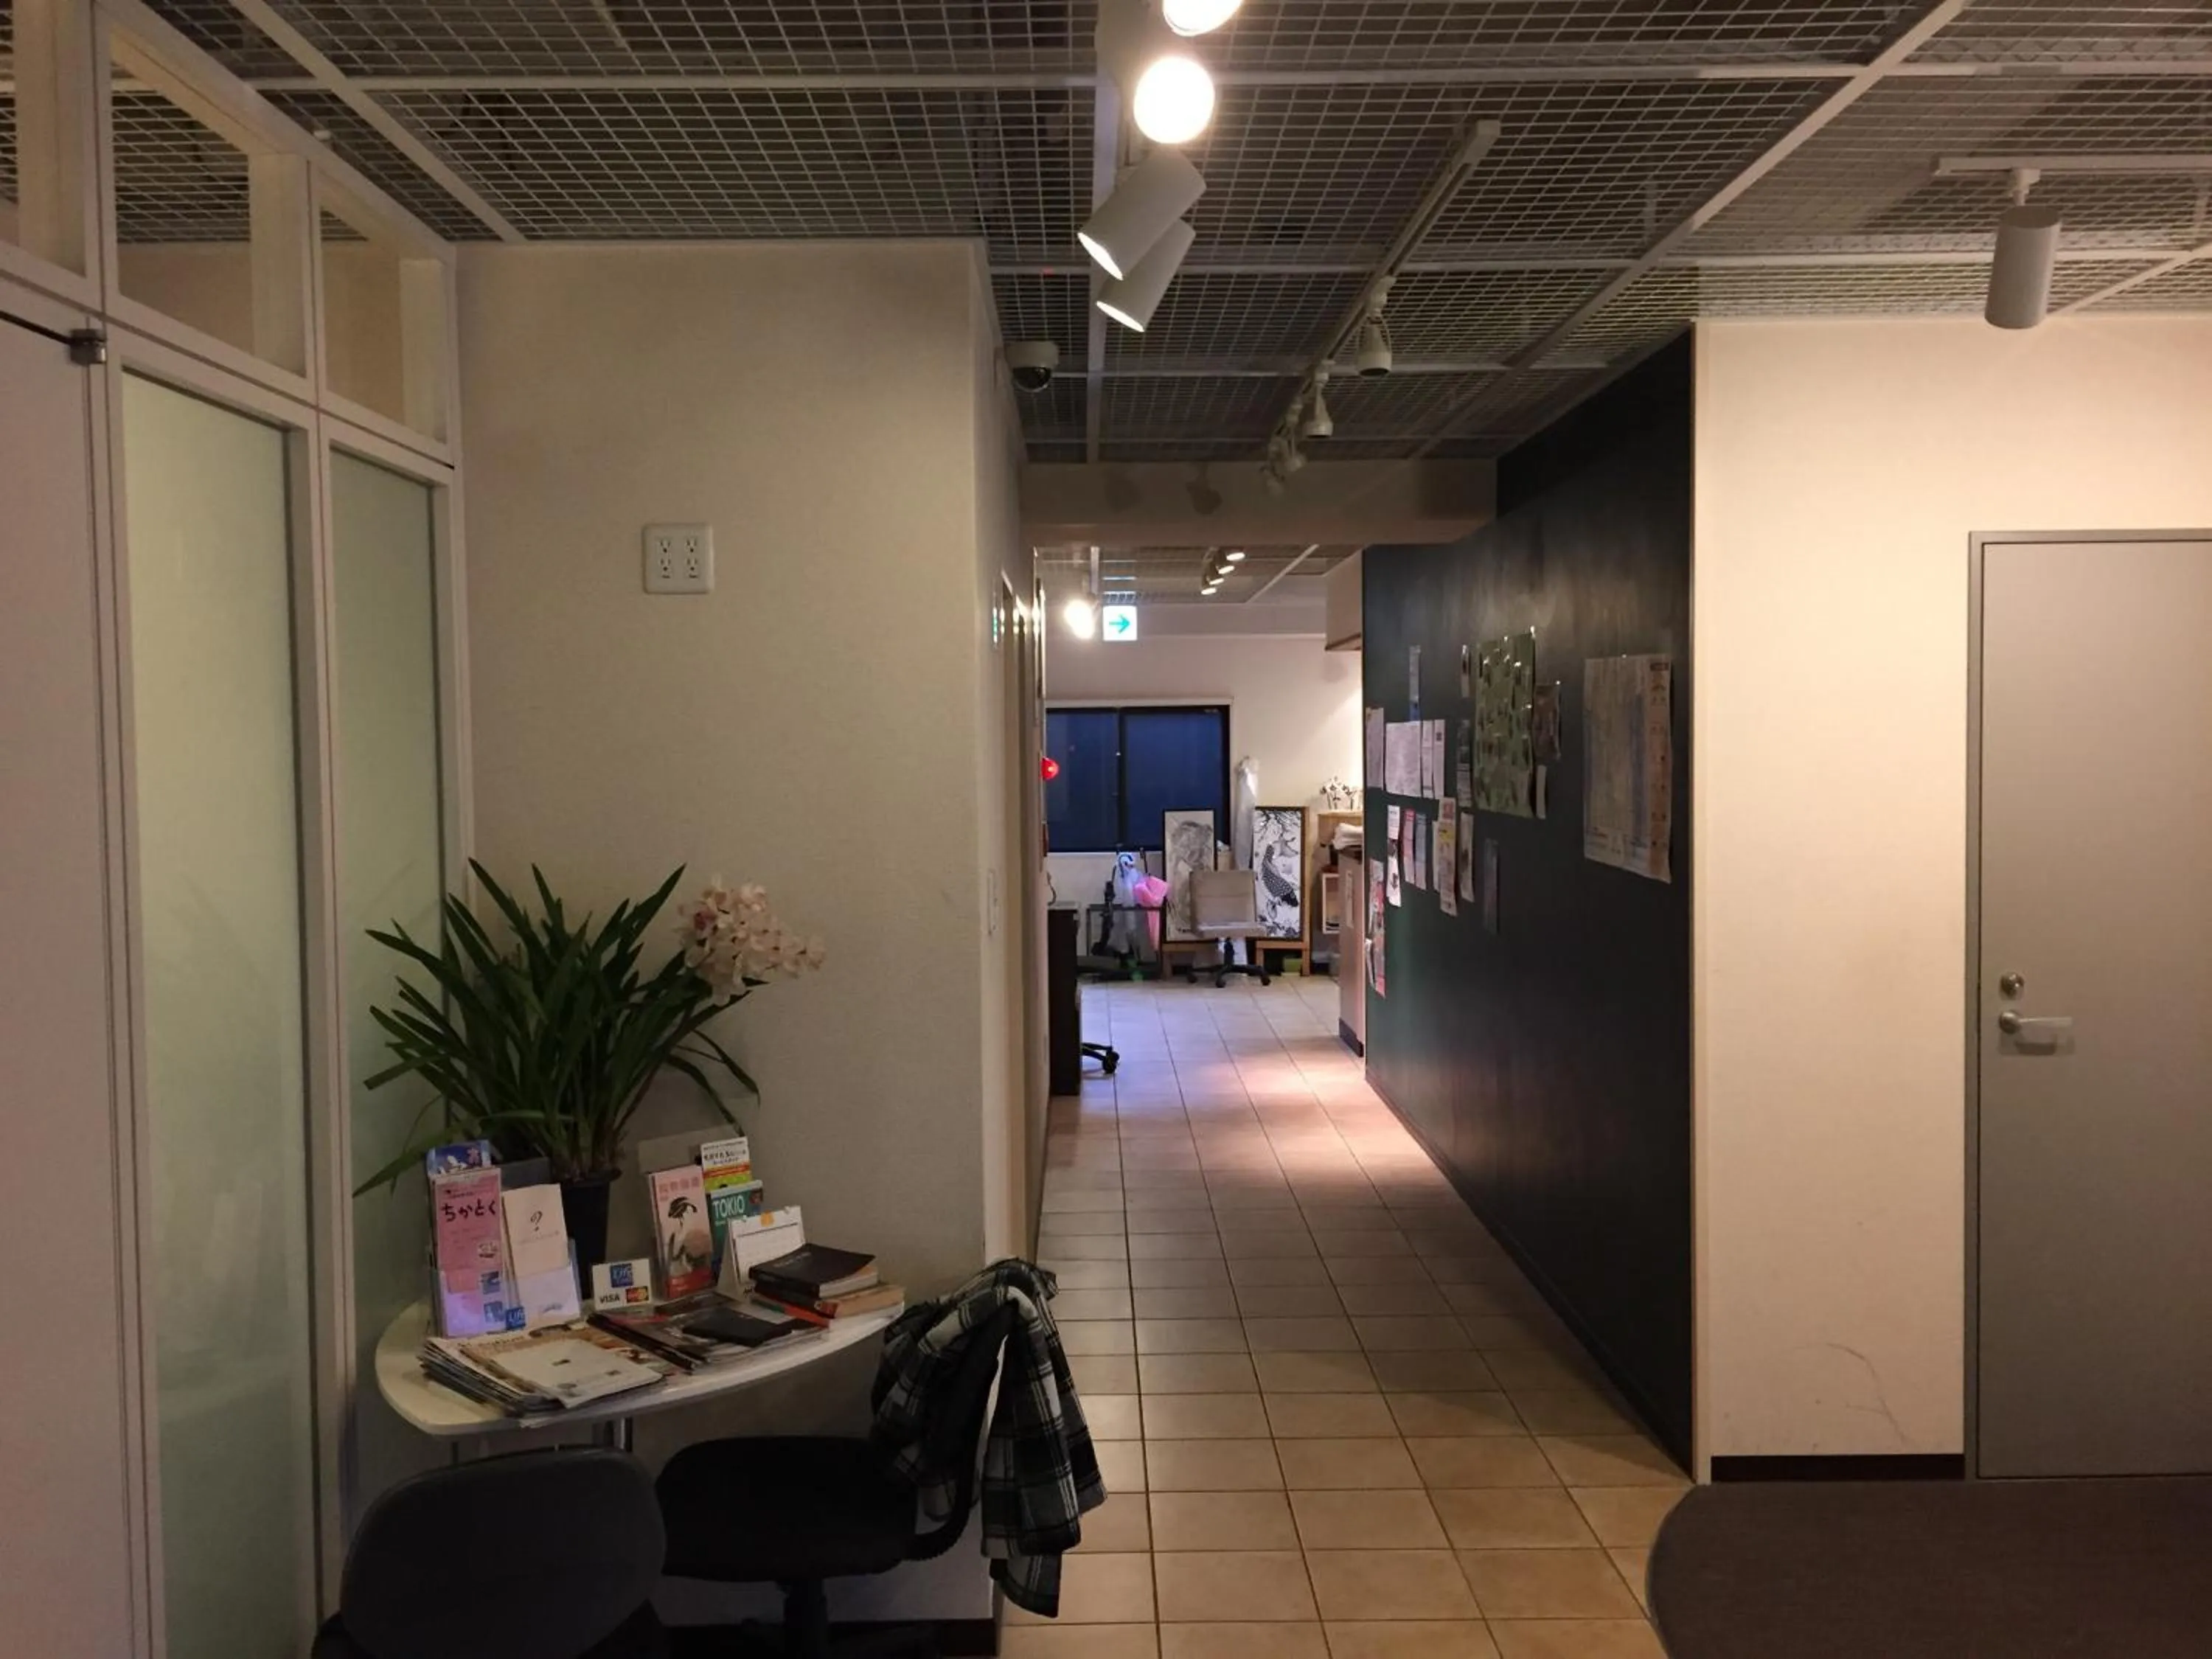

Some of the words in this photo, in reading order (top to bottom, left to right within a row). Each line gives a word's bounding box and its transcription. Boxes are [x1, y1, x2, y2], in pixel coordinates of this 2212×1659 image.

[441, 1198, 496, 1222] ちかとく
[599, 1292, 620, 1304] VISA
